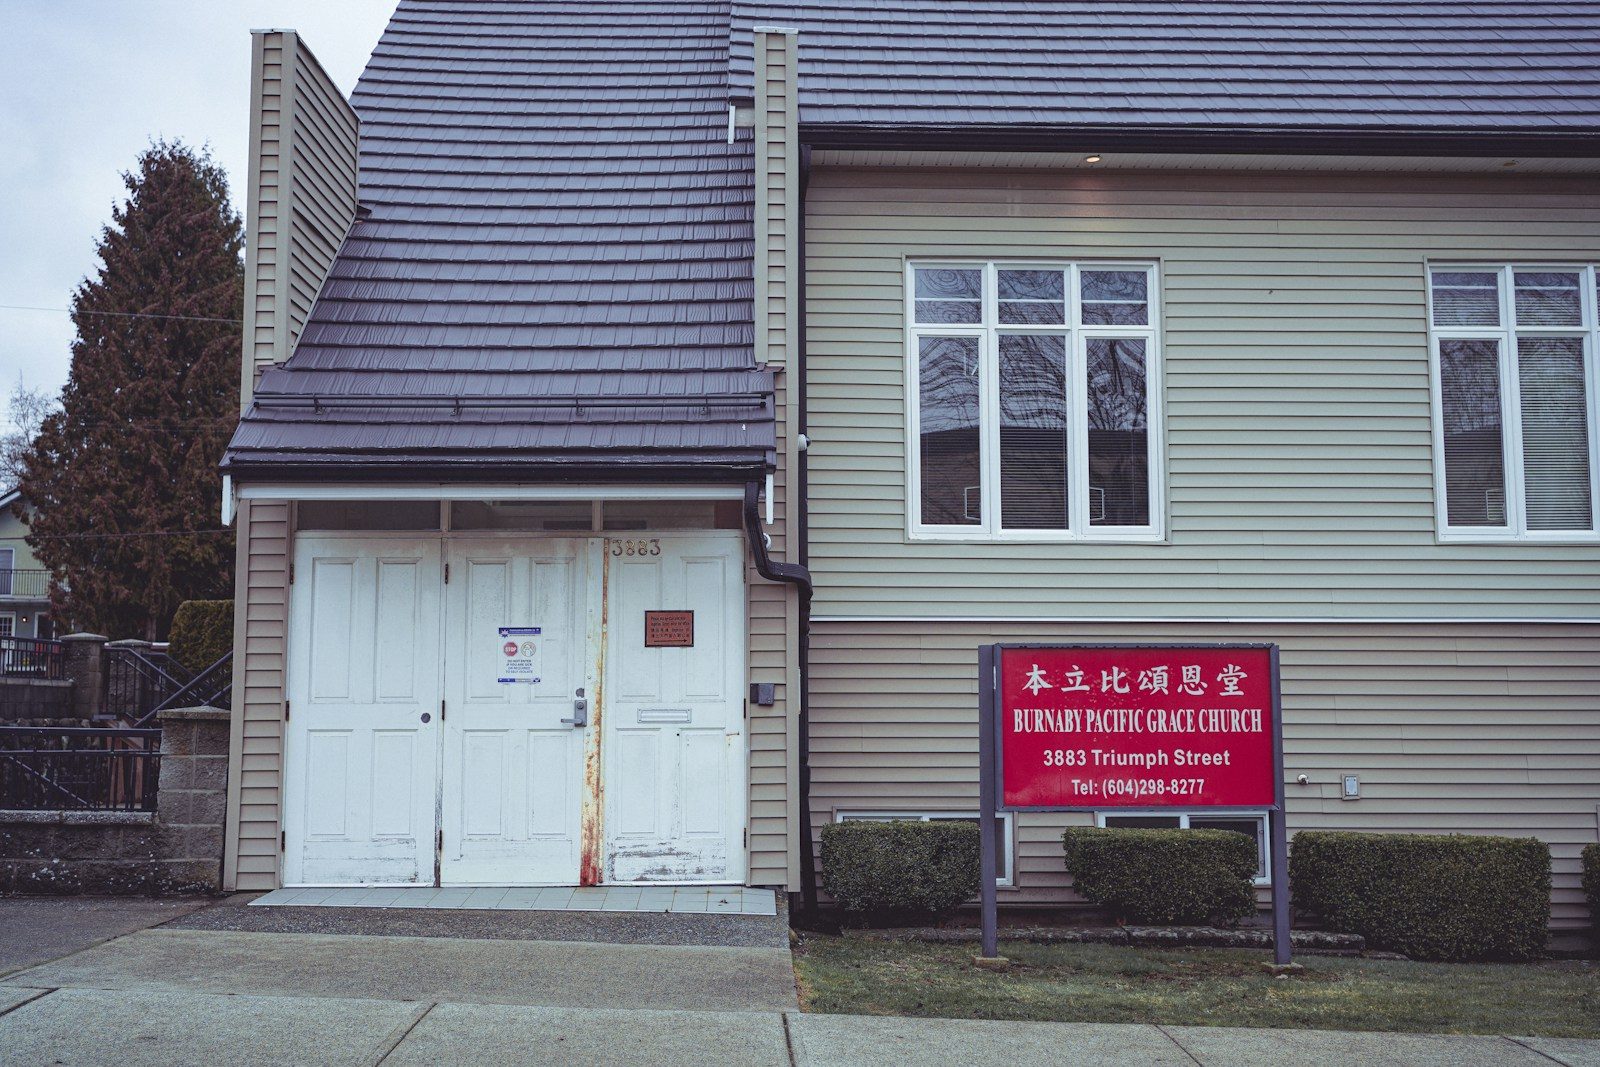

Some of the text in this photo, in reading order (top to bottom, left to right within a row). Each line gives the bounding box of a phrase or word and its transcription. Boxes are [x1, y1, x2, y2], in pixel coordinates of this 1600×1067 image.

[612, 538, 661, 556] 3883
[1022, 663, 1248, 697] 本立比頌恩堂
[1013, 708, 1263, 733] BURNABY PACIFIC GRACE CHURCH
[1043, 749, 1231, 770] 3883 Triumph Street
[1071, 778, 1206, 799] Tel: (604)298-8277
